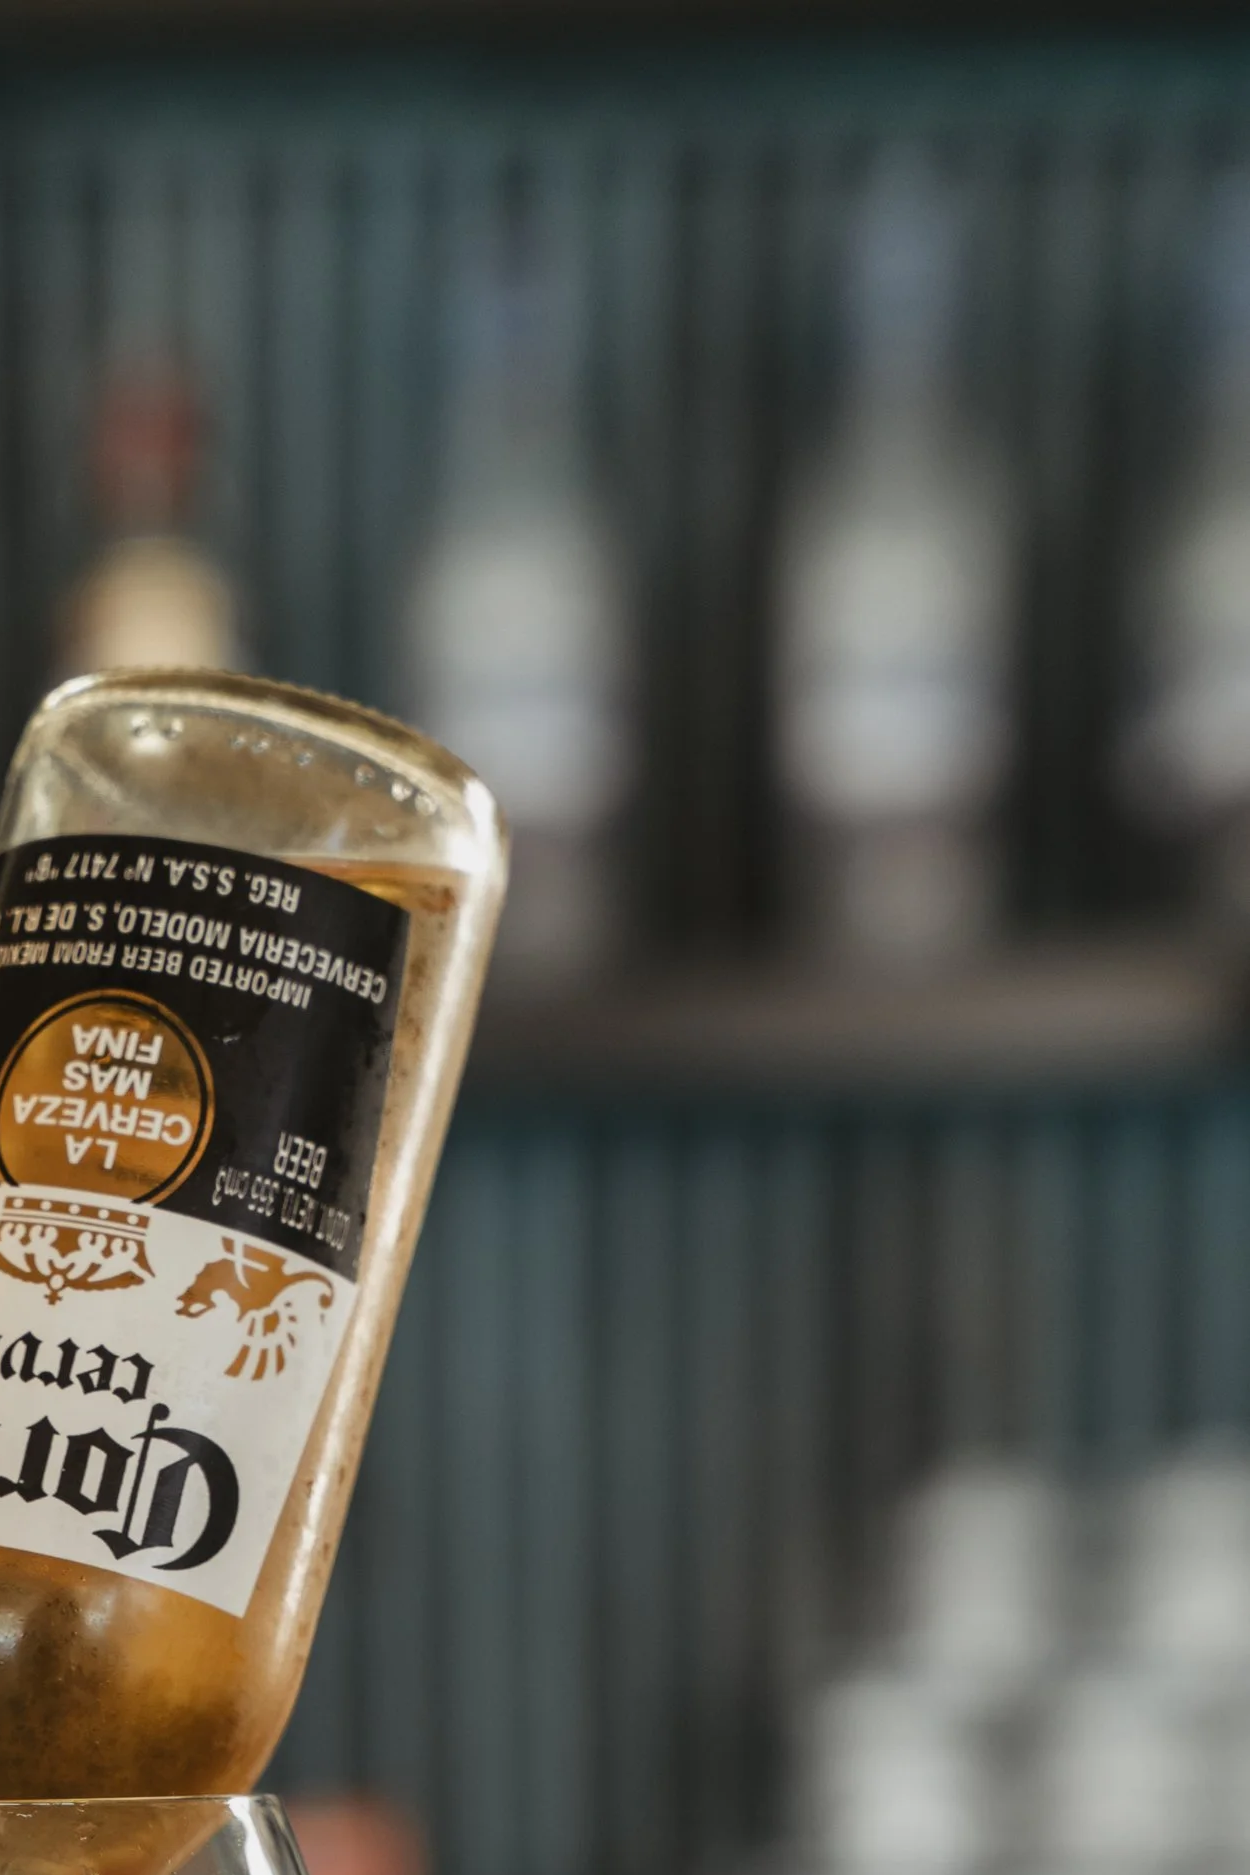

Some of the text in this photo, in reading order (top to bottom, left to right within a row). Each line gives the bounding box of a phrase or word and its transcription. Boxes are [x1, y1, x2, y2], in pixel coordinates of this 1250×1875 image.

[63, 852, 120, 881] 7417
[162, 856, 237, 896] S.S.A.
[245, 871, 302, 914] REG.
[43, 902, 78, 932] DE
[83, 902, 107, 932] S.
[113, 901, 233, 950] MODELO,
[52, 940, 117, 967] FROM
[121, 944, 184, 976] BEER
[239, 926, 388, 1004] CERVECERIA
[189, 955, 313, 1010] IMPORTED
[71, 1023, 164, 1065] FINA
[62, 1060, 153, 1101] MAS
[12, 1093, 193, 1146] CERVEZA
[65, 1133, 119, 1170] LA
[273, 1130, 328, 1189] BEER
[247, 1175, 280, 1217] 355
